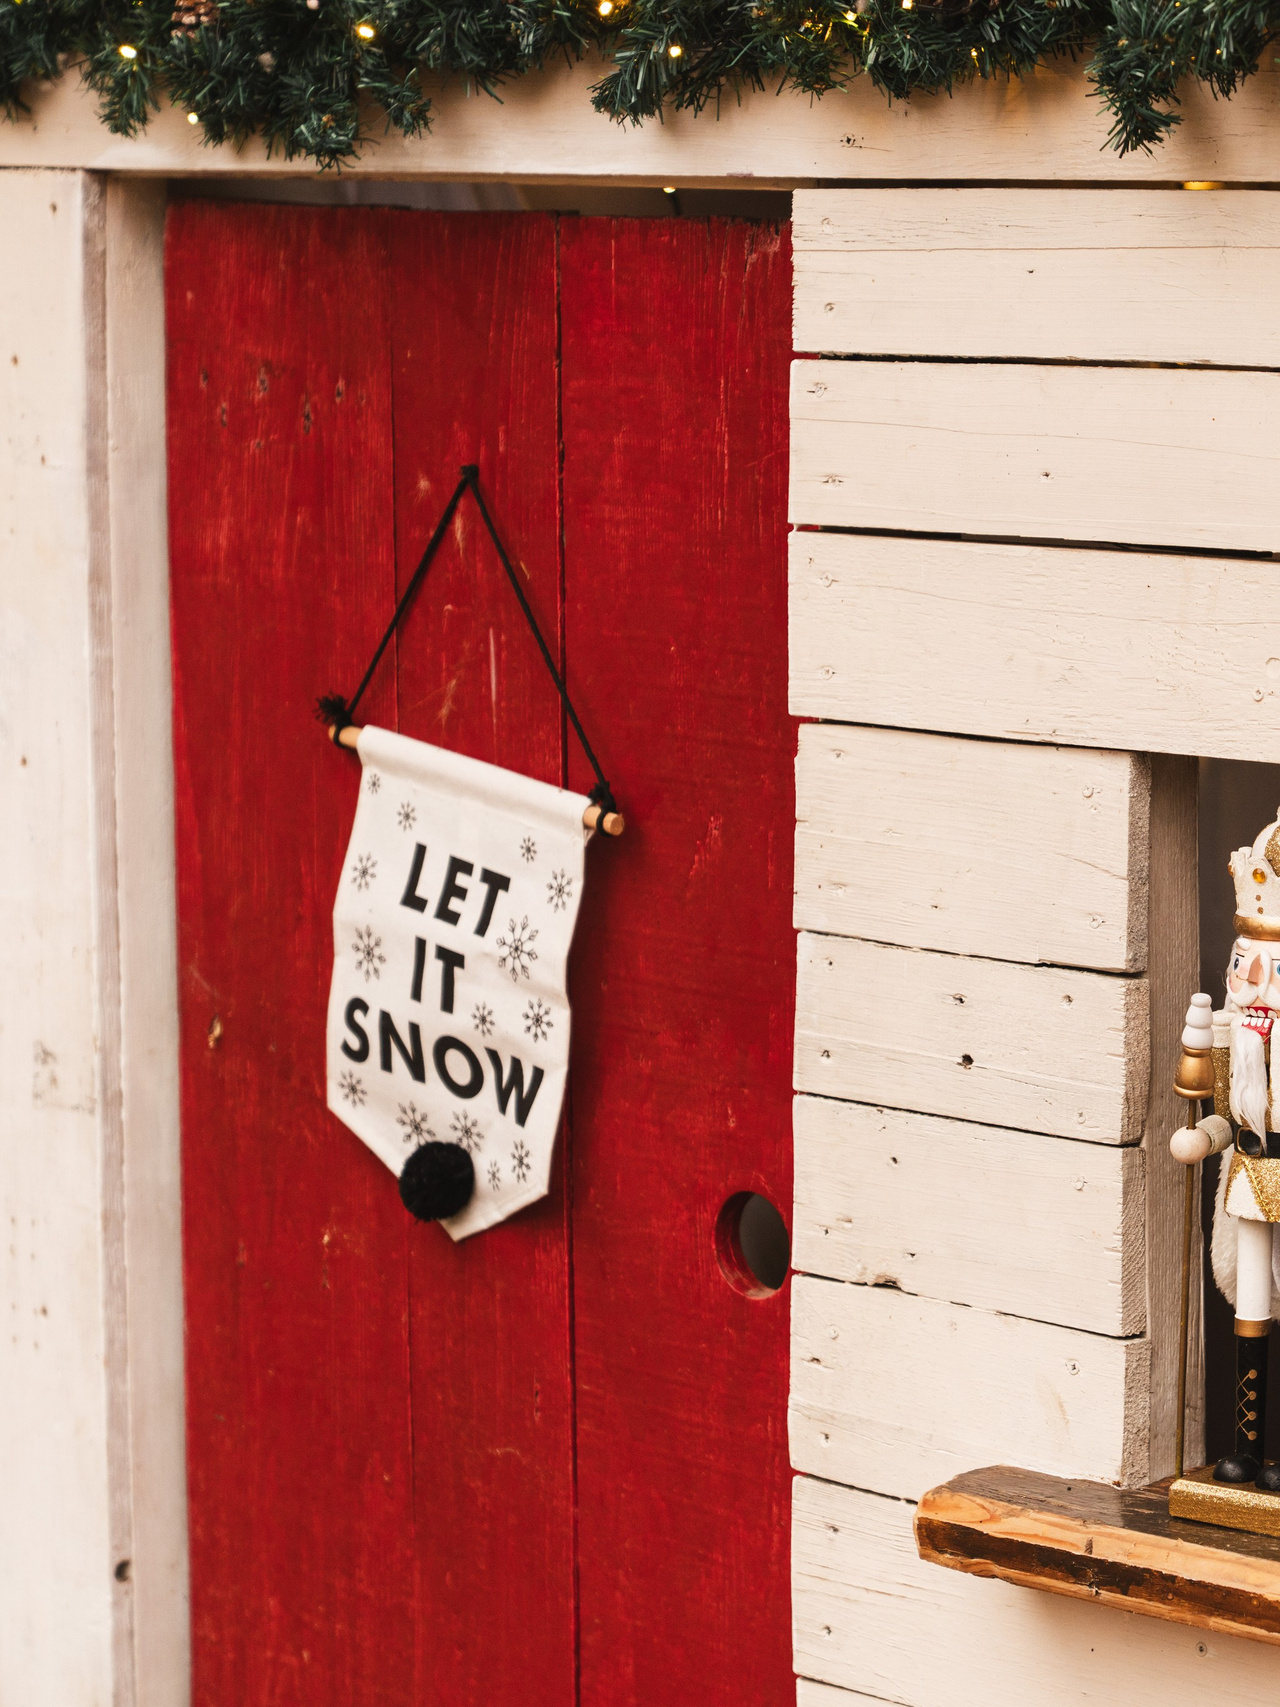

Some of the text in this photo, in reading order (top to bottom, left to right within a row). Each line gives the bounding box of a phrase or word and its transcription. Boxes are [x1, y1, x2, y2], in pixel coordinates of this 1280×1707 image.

[400, 842, 511, 938] LET
[410, 936, 465, 1014] IT
[341, 996, 545, 1128] SNOW
